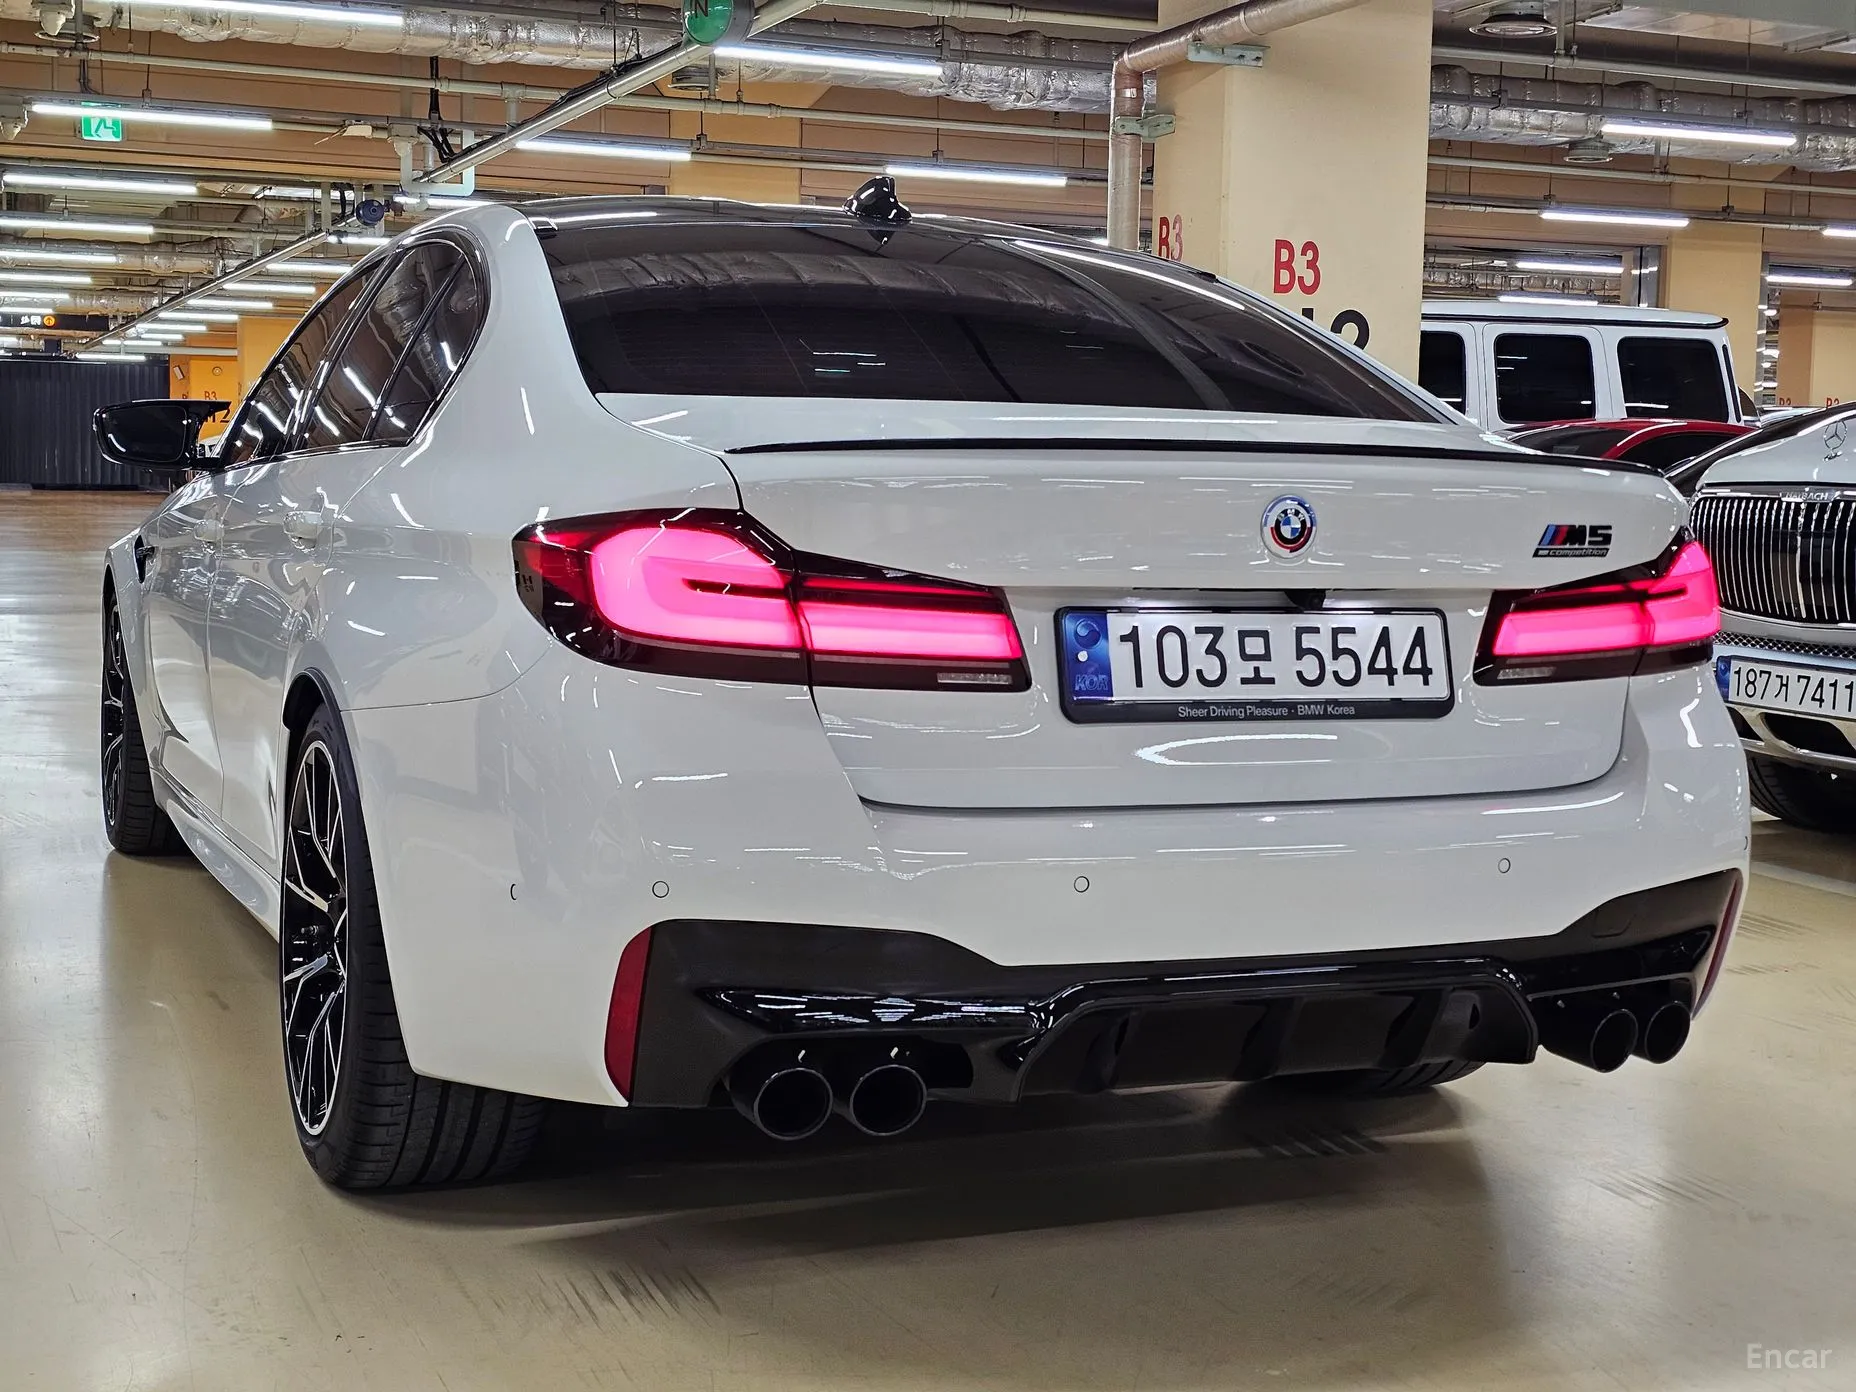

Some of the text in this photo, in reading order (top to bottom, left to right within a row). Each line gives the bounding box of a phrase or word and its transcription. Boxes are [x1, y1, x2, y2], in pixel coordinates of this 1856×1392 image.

[1158, 214, 1183, 262] B3
[1273, 239, 1321, 296] B3
[1277, 508, 1306, 522] BMW
[1560, 525, 1612, 546] M5
[1549, 548, 1607, 557] competition
[1119, 625, 1433, 688] 103모 5544
[1074, 674, 1109, 691] KOR
[1734, 666, 1854, 712] 187거 7411
[1178, 704, 1356, 719] Sheer Driving Pleasure BMW Korea
